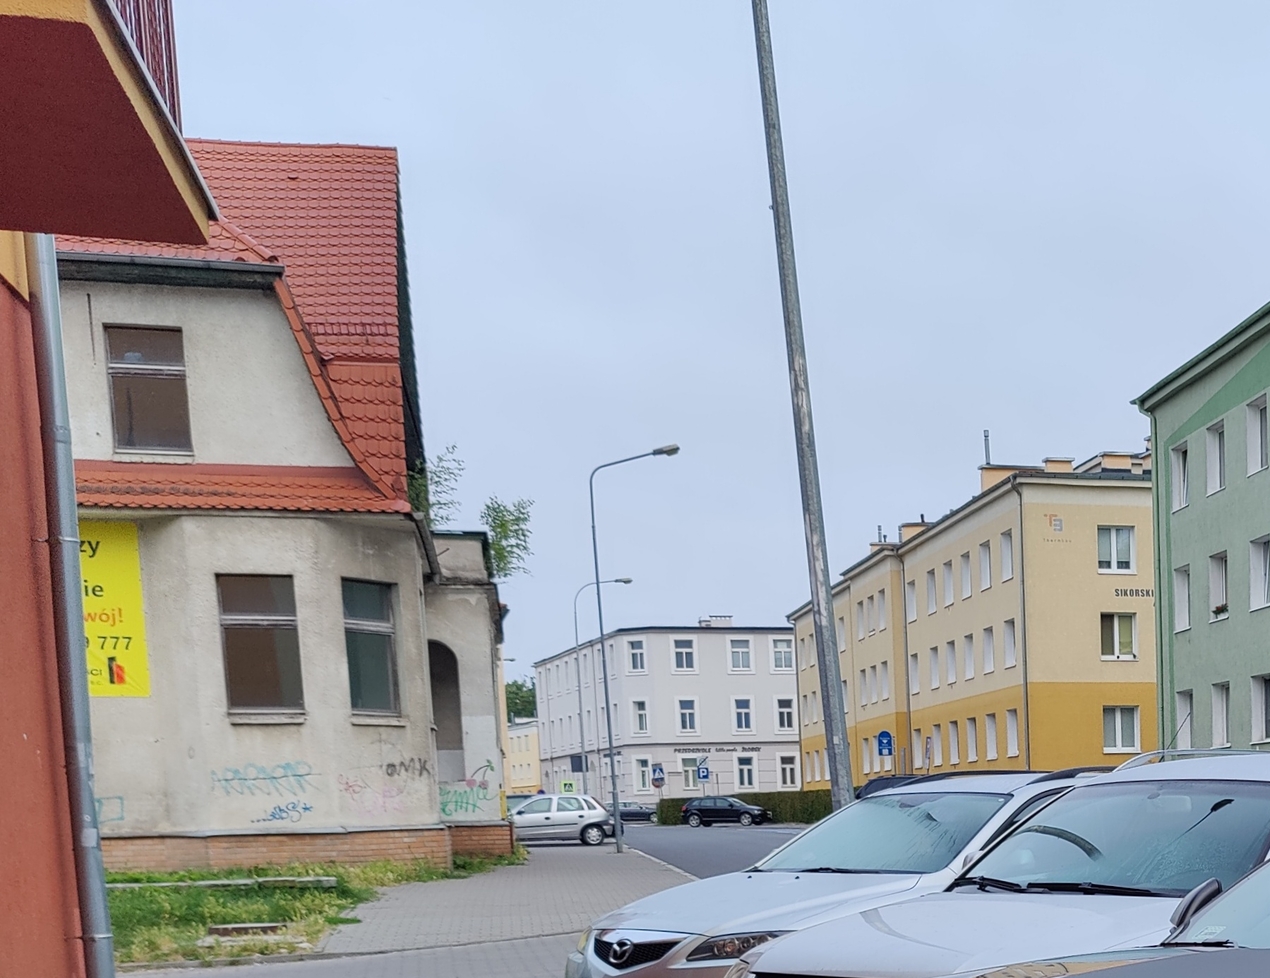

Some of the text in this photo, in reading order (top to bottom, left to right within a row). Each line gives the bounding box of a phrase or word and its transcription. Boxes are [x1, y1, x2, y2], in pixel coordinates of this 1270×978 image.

[1114, 588, 1154, 598] SIKORSKI
[97, 636, 132, 650] 777
[700, 768, 708, 778] P
